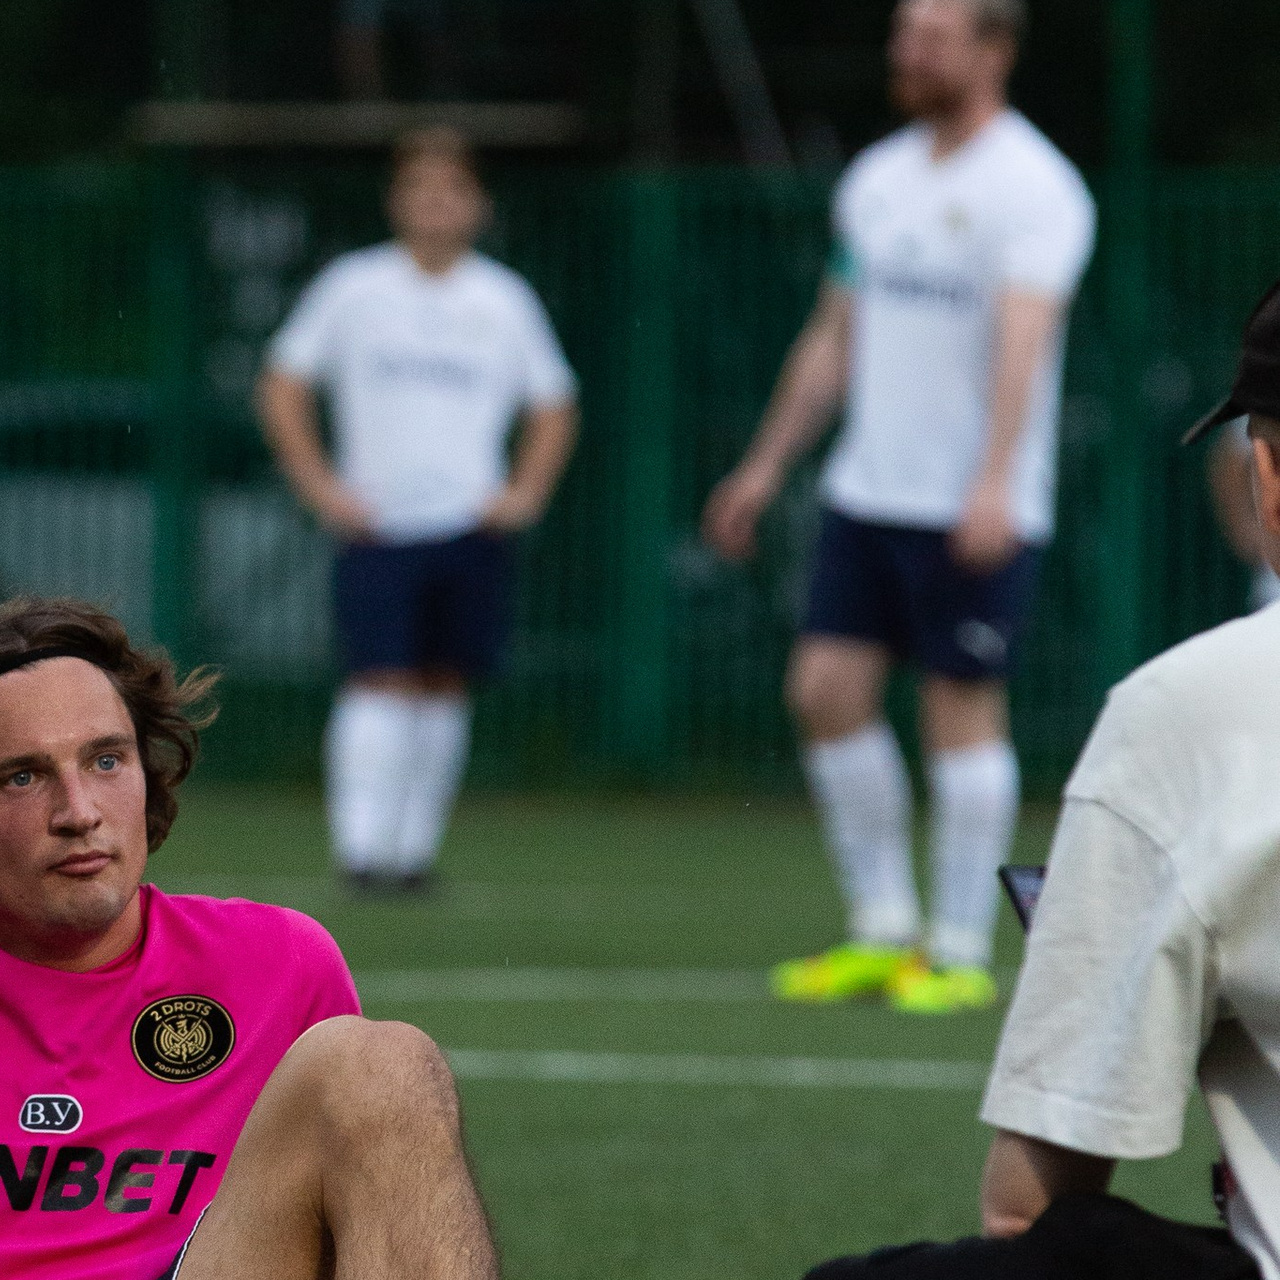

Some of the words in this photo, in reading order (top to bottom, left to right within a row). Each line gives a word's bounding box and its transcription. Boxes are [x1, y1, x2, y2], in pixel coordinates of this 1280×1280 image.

[150, 1010, 162, 1021] 2
[161, 1001, 212, 1016] DROTS
[154, 1061, 196, 1075] FOOTBALL
[196, 1055, 216, 1070] CLUB
